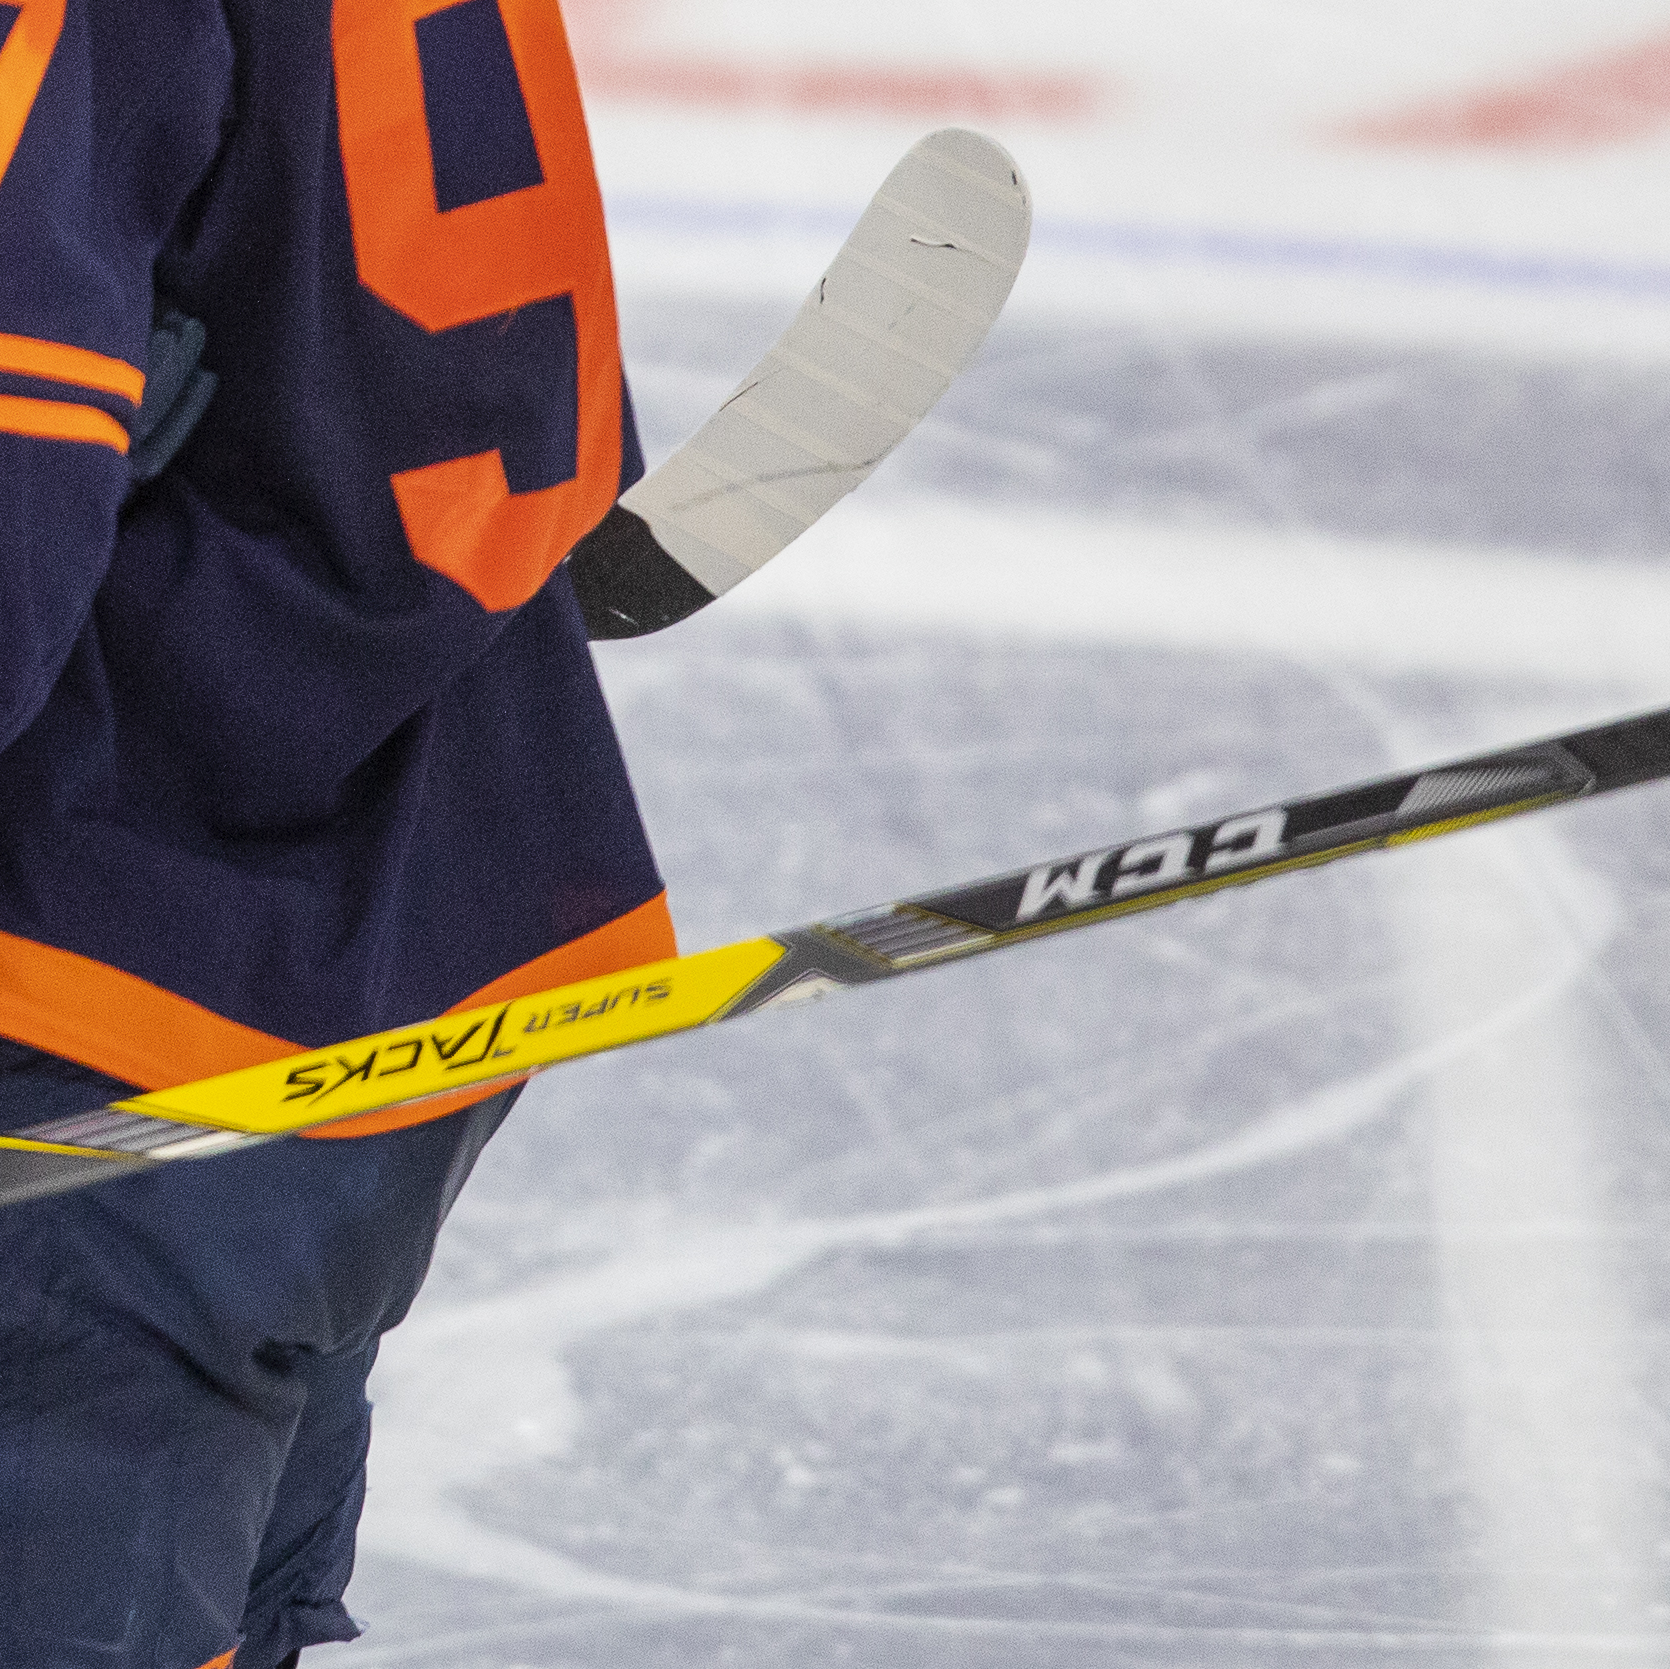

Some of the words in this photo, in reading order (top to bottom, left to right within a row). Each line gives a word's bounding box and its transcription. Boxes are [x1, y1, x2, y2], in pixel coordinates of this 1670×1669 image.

[1015, 808, 1289, 923] CCM
[280, 1000, 516, 1107] TACKS
[522, 976, 674, 1034] SUPER
